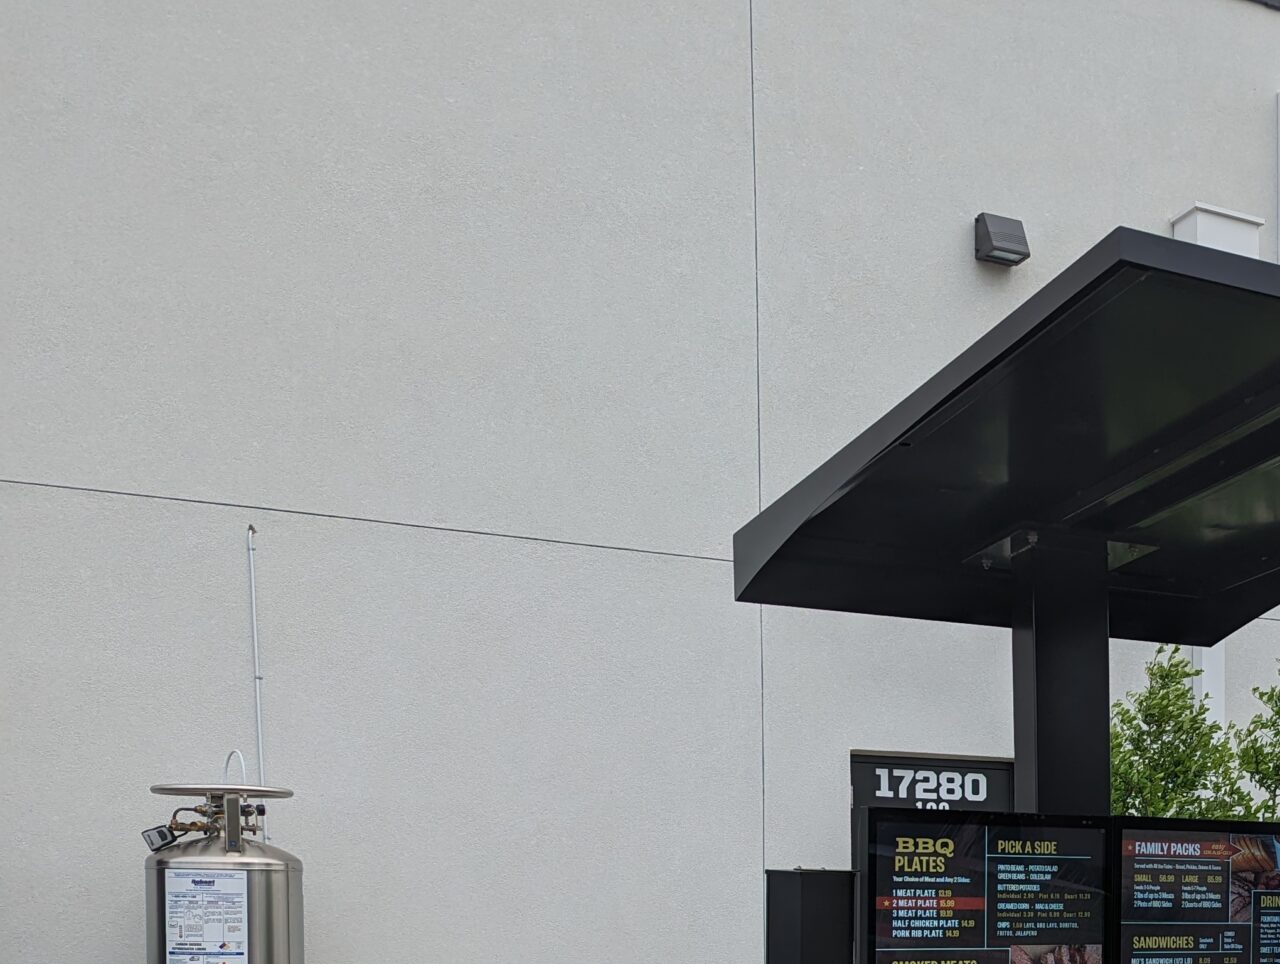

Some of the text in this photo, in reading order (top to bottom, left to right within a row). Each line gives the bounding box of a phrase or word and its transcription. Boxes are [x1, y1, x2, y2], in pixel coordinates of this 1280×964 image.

[875, 768, 987, 801] 17280
[895, 837, 954, 857] BBQ
[997, 840, 1057, 854] PICK A SIDE
[1135, 842, 1168, 854] FAMILY
[1171, 843, 1200, 855] PACKS
[895, 856, 945, 872] PLATES
[1134, 874, 1152, 882] SMALL
[1133, 936, 1194, 948] SANDWICHES
